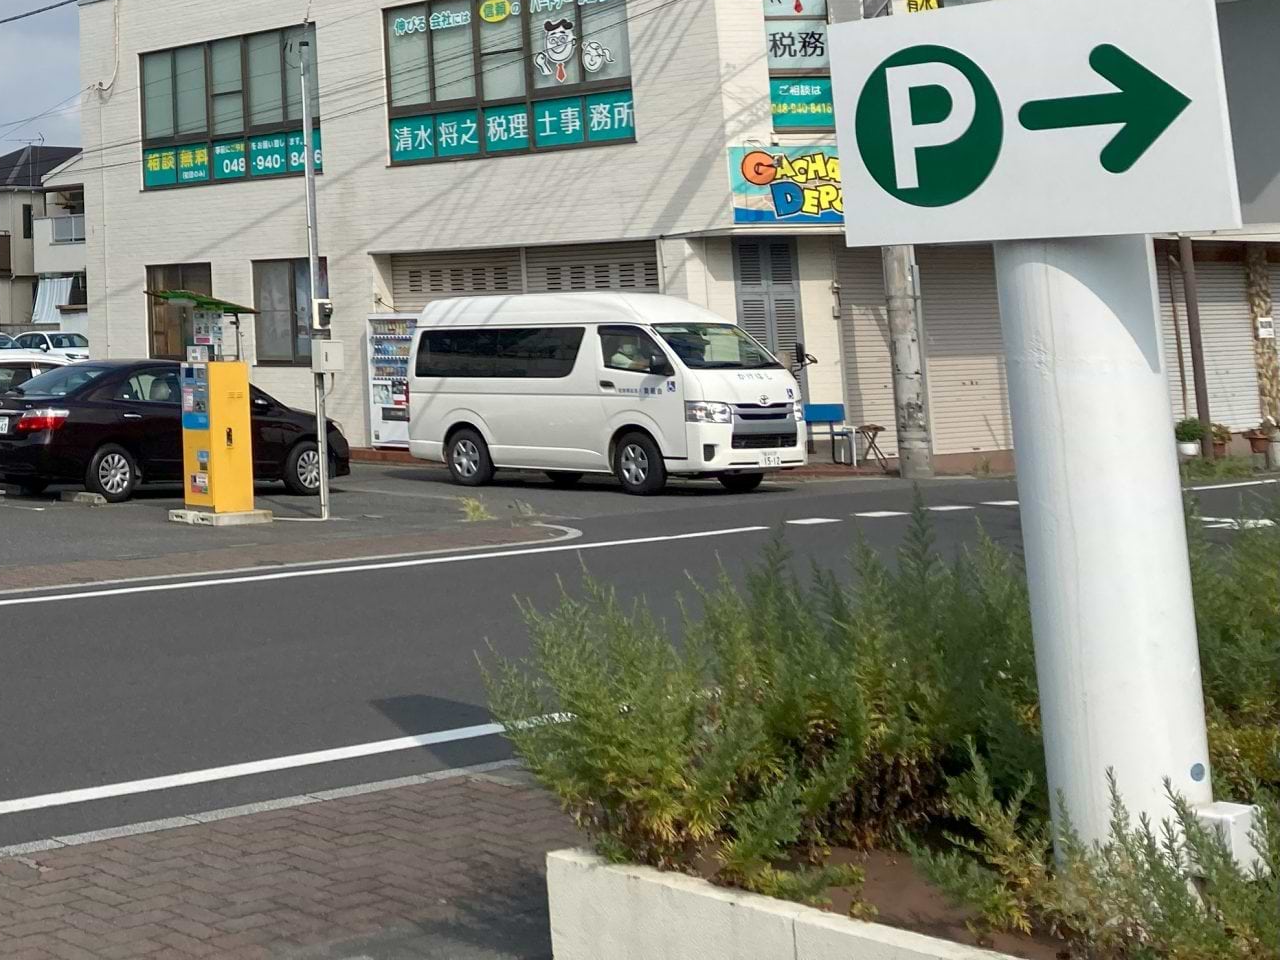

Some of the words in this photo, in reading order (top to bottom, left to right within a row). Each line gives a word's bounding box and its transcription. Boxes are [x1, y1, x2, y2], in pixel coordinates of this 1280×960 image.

[769, 31, 824, 58] 税務
[778, 85, 822, 96] ご相談は
[885, 62, 976, 189] P
[223, 149, 322, 174] 048-940-846
